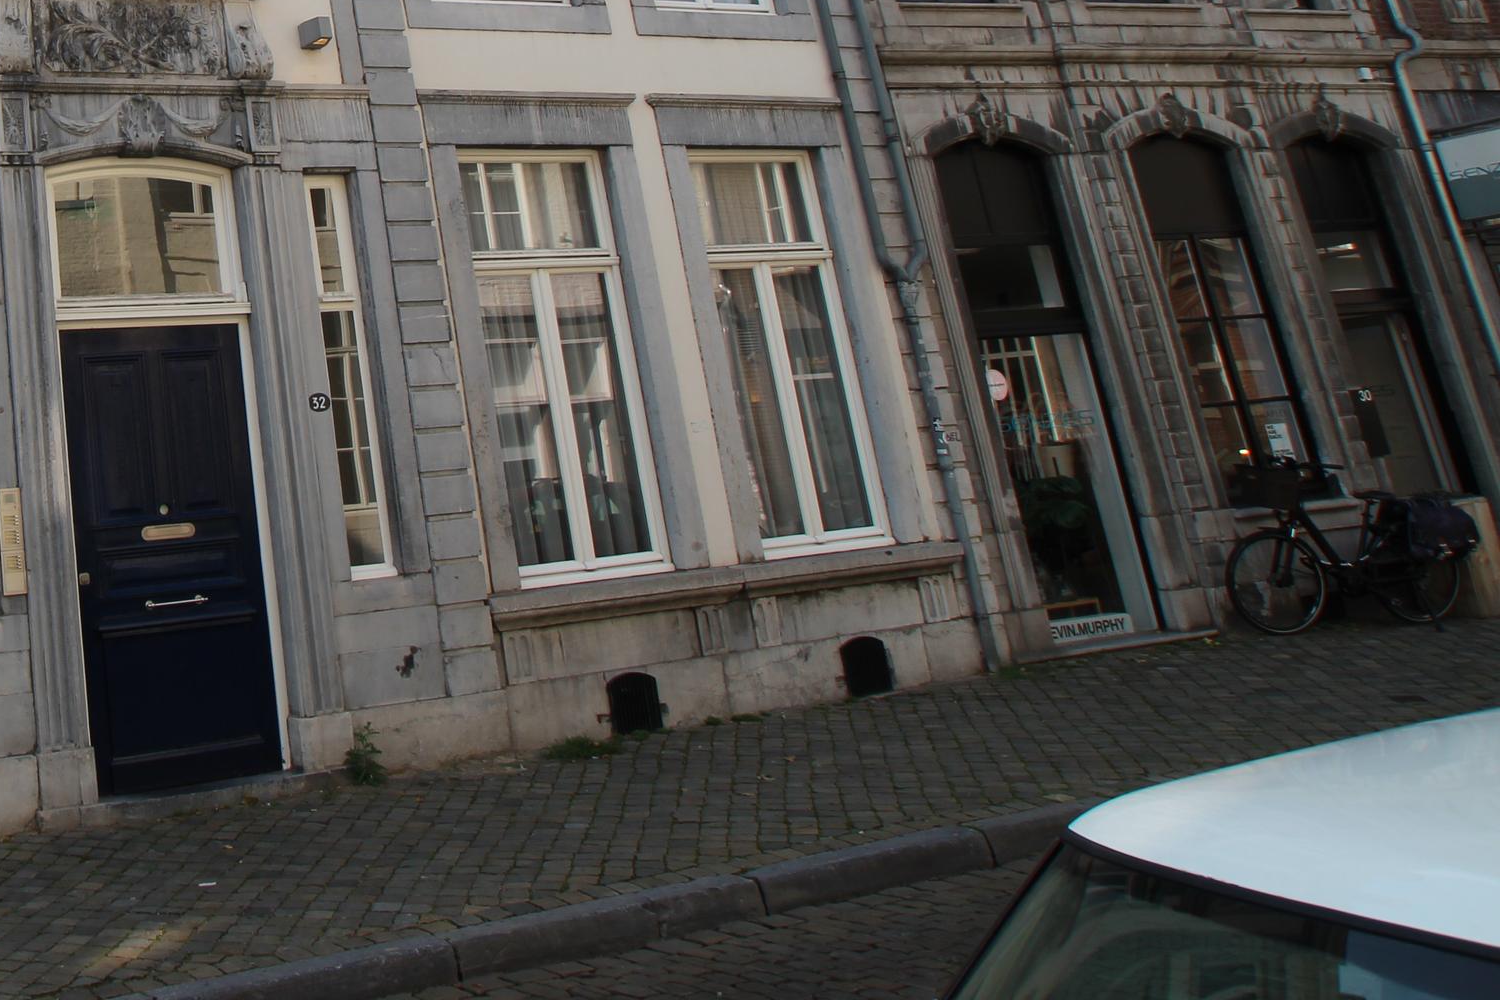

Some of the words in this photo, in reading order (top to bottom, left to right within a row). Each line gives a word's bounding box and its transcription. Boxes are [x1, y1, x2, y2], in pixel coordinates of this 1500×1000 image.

[1358, 389, 1372, 402] 30
[312, 396, 326, 410] 32
[1051, 617, 1125, 640] EVIN.MURPHY
